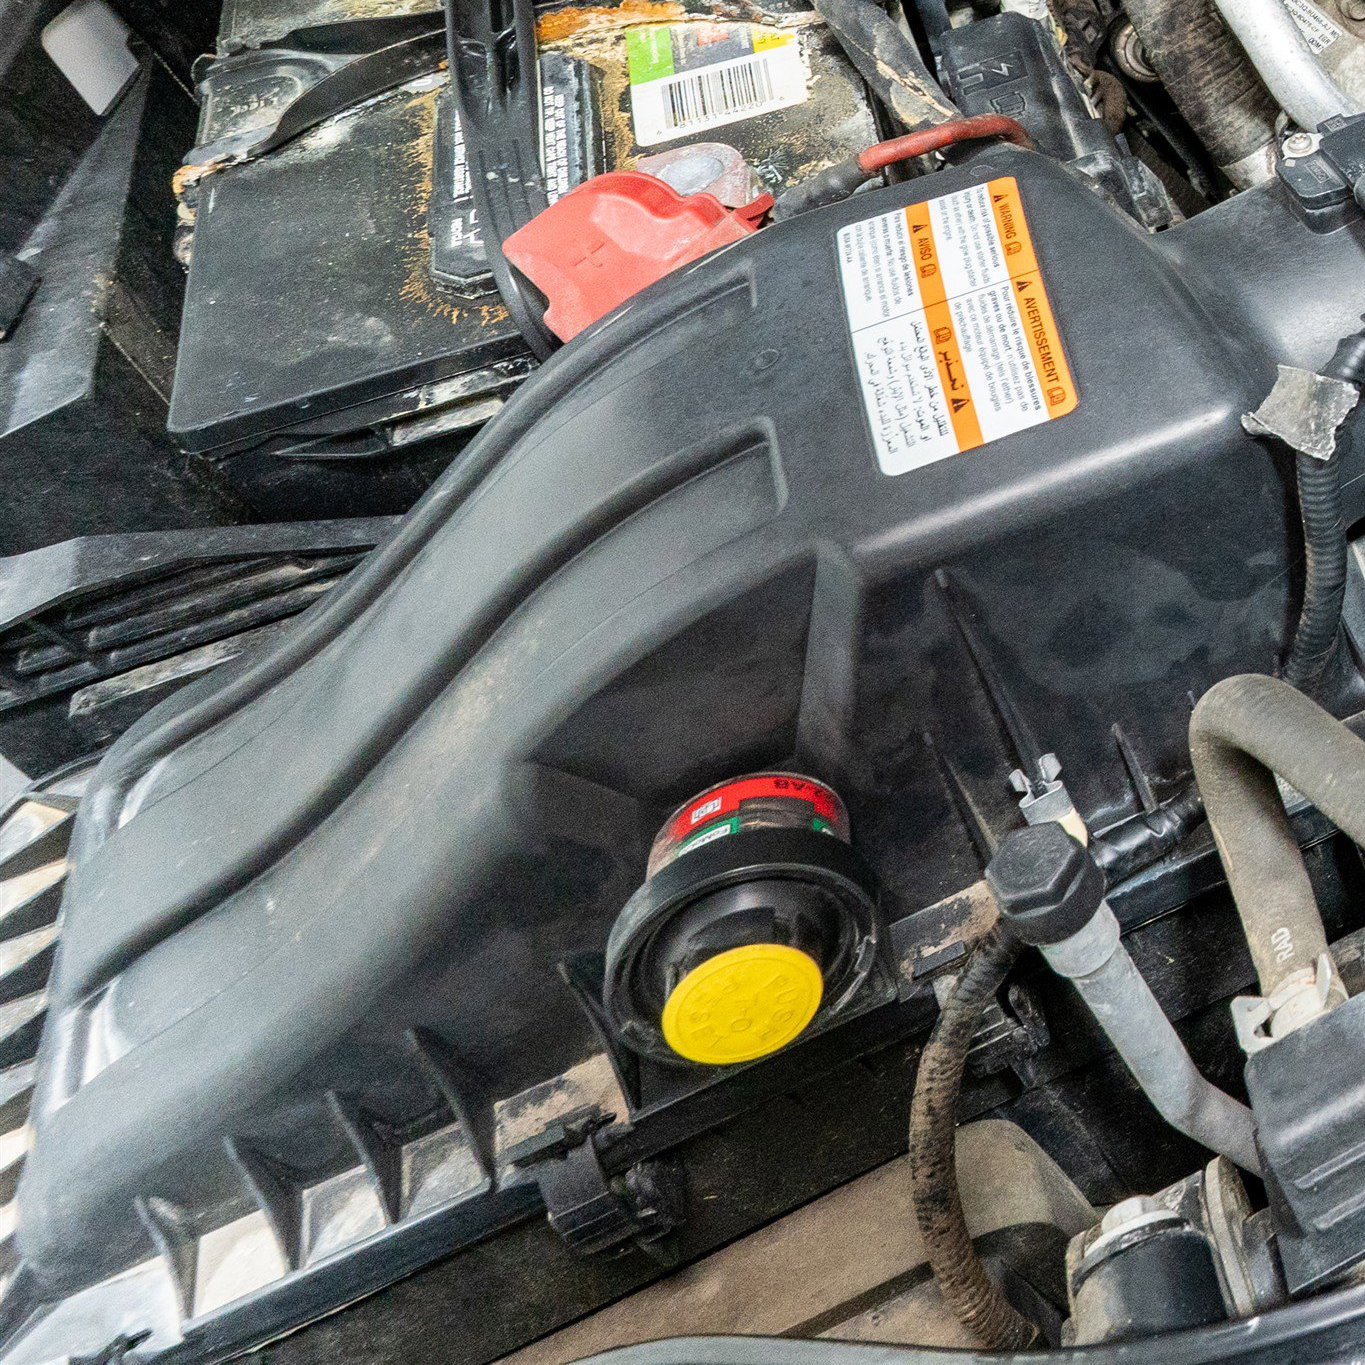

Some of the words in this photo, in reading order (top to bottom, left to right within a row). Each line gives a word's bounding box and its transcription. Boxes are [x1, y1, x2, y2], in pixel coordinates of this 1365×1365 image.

[997, 202, 1017, 240] WARNING
[915, 235, 933, 262] AVISO
[999, 285, 1012, 302] Pour
[1011, 327, 1021, 335] le
[1023, 295, 1059, 384] AVERTISSEMENT
[1013, 335, 1026, 360] risque
[1020, 359, 1031, 371] de
[1023, 370, 1041, 411] blessures
[1271, 926, 1295, 963] RAD
